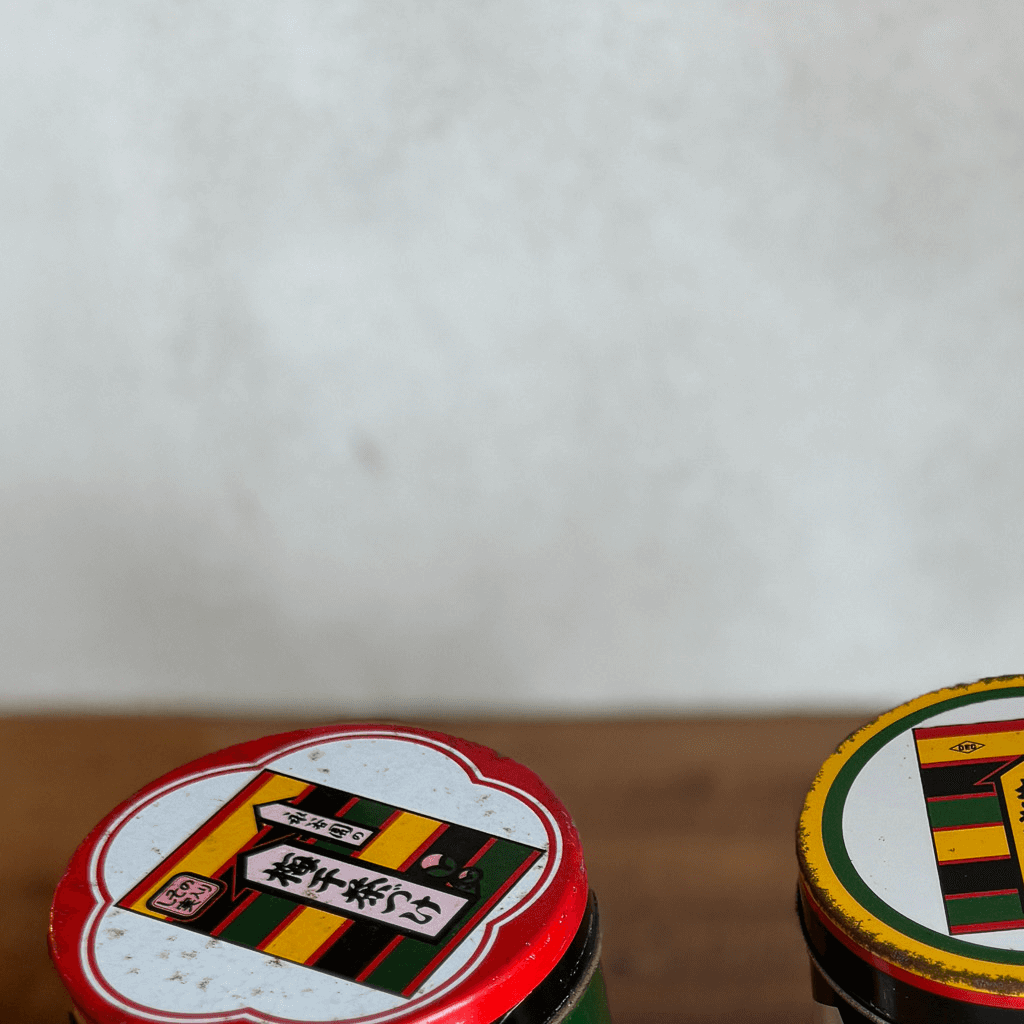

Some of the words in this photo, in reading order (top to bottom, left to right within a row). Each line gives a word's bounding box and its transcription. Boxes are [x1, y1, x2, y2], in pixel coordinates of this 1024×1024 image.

[263, 852, 442, 925] 梅干茶づけ
